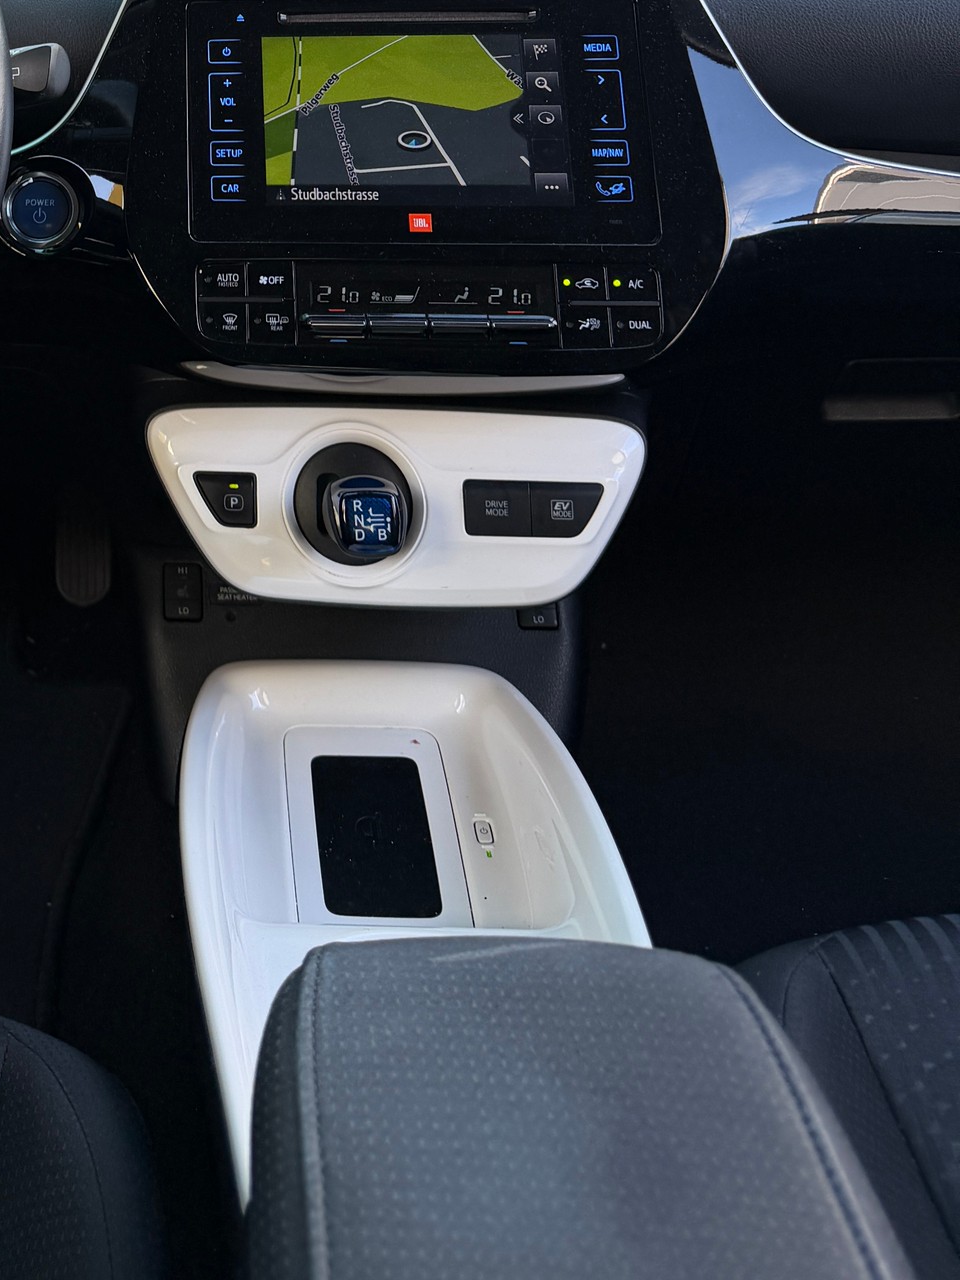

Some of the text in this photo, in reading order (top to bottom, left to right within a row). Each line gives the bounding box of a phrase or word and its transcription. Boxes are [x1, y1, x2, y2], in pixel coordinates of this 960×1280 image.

[583, 43, 612, 53] MEDIA
[300, 72, 340, 116] Pilgerweg
[219, 97, 237, 107] VOL
[215, 148, 243, 159] SETUP
[591, 147, 624, 159] MAP/NAV
[221, 183, 239, 194] CAR
[290, 187, 379, 201] Studbachstrasse
[25, 198, 55, 207] POWER
[217, 273, 239, 282] AUTO
[268, 276, 285, 285] OFF
[628, 280, 644, 289] A/C
[629, 320, 652, 330] DUAL
[353, 500, 363, 512] R
[485, 500, 508, 508] DRIVE
[554, 502, 570, 510] EV
[485, 508, 509, 517] MODE
[553, 510, 572, 518] MODE
[353, 514, 364, 526] N
[355, 529, 365, 541] D
[378, 529, 388, 541] B
[178, 607, 190, 615] LO
[533, 616, 545, 624] LO
